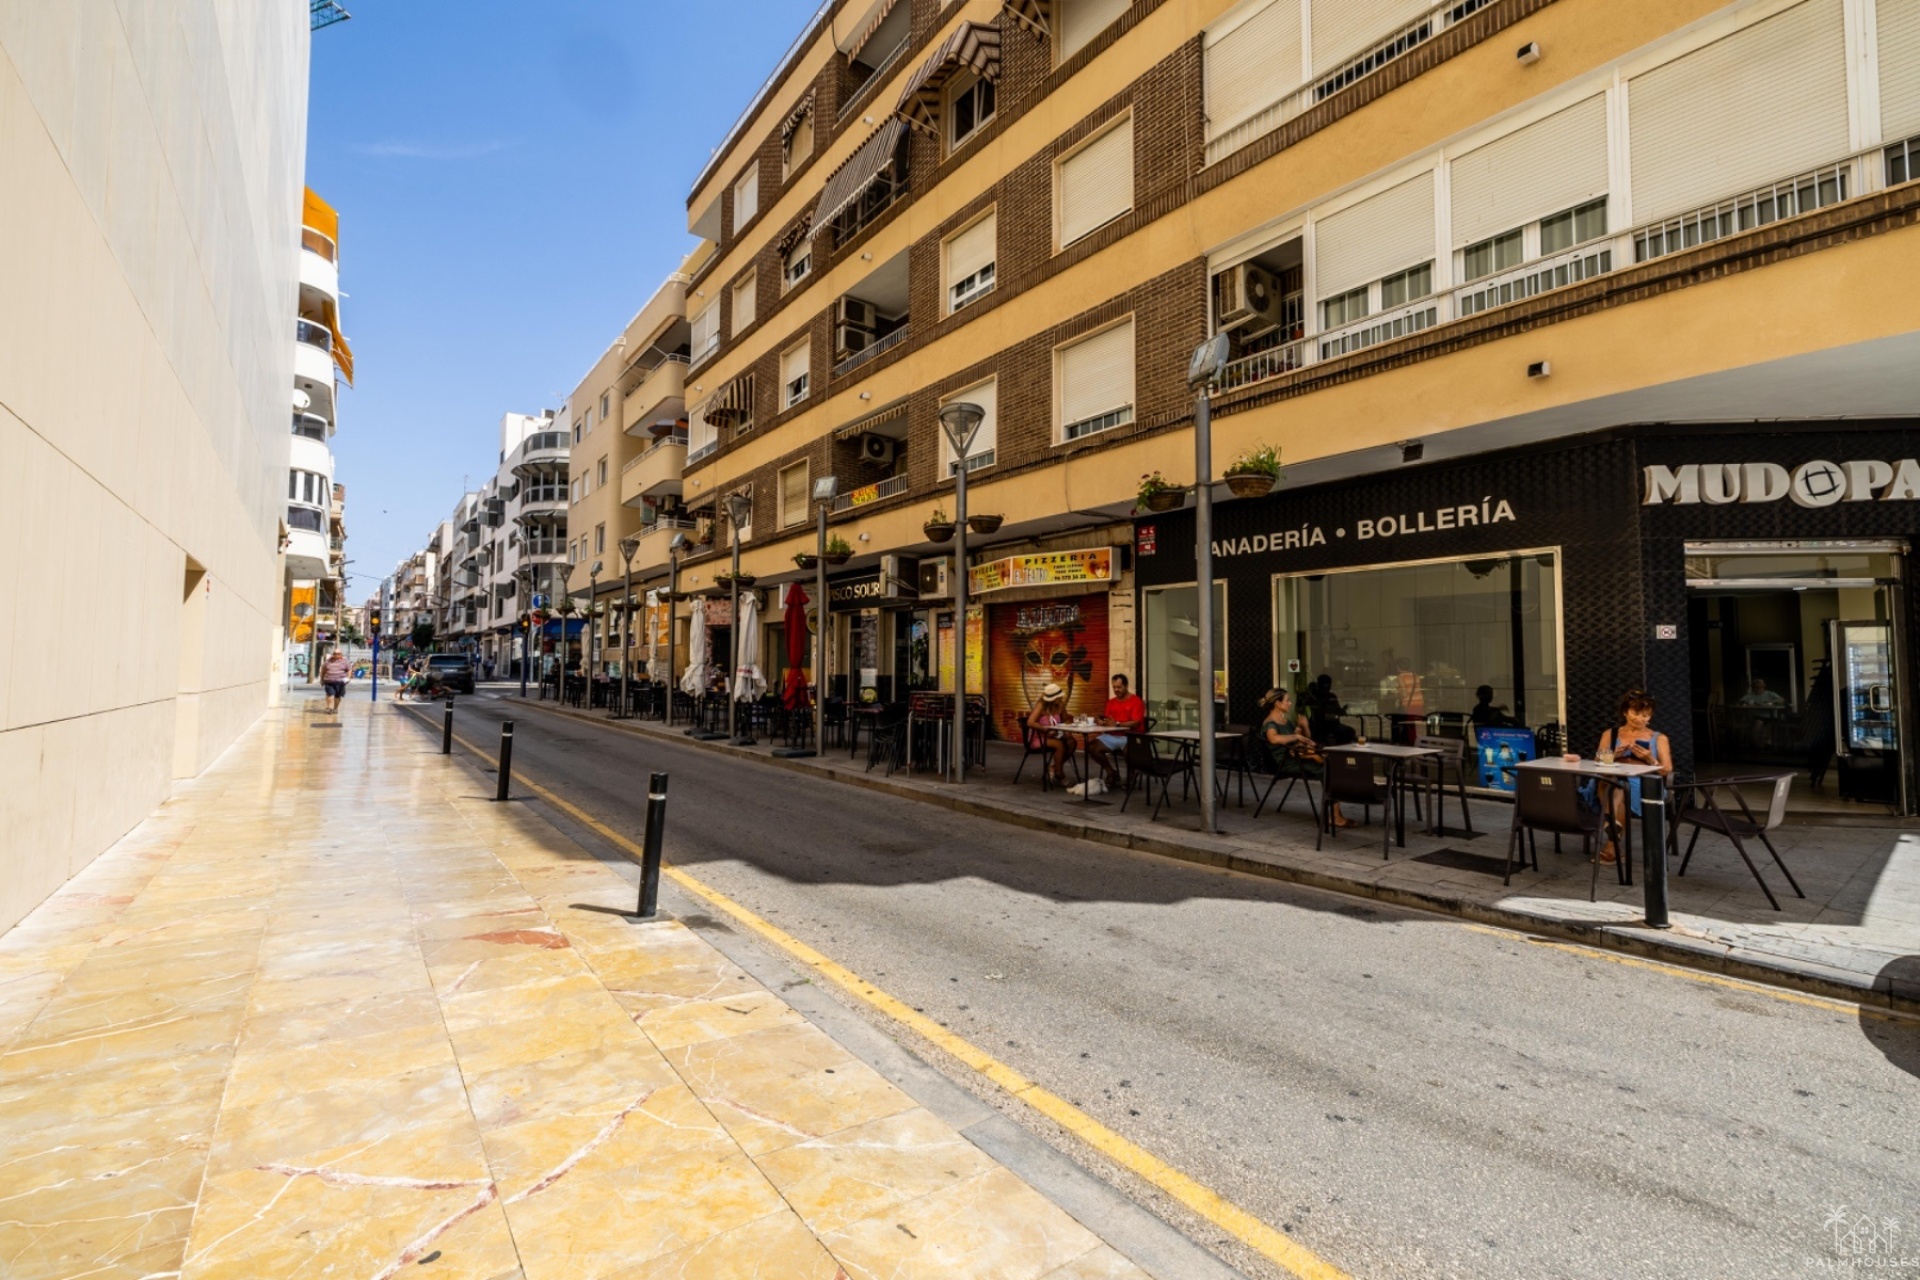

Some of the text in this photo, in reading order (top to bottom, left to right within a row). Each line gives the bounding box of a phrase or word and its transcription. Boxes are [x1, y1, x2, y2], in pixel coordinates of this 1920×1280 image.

[1195, 523, 1326, 560] ANADERÍA
[1357, 496, 1516, 540] BOLLERÍA
[1024, 553, 1097, 565] PIZZERIA
[854, 582, 880, 598] SOUR
